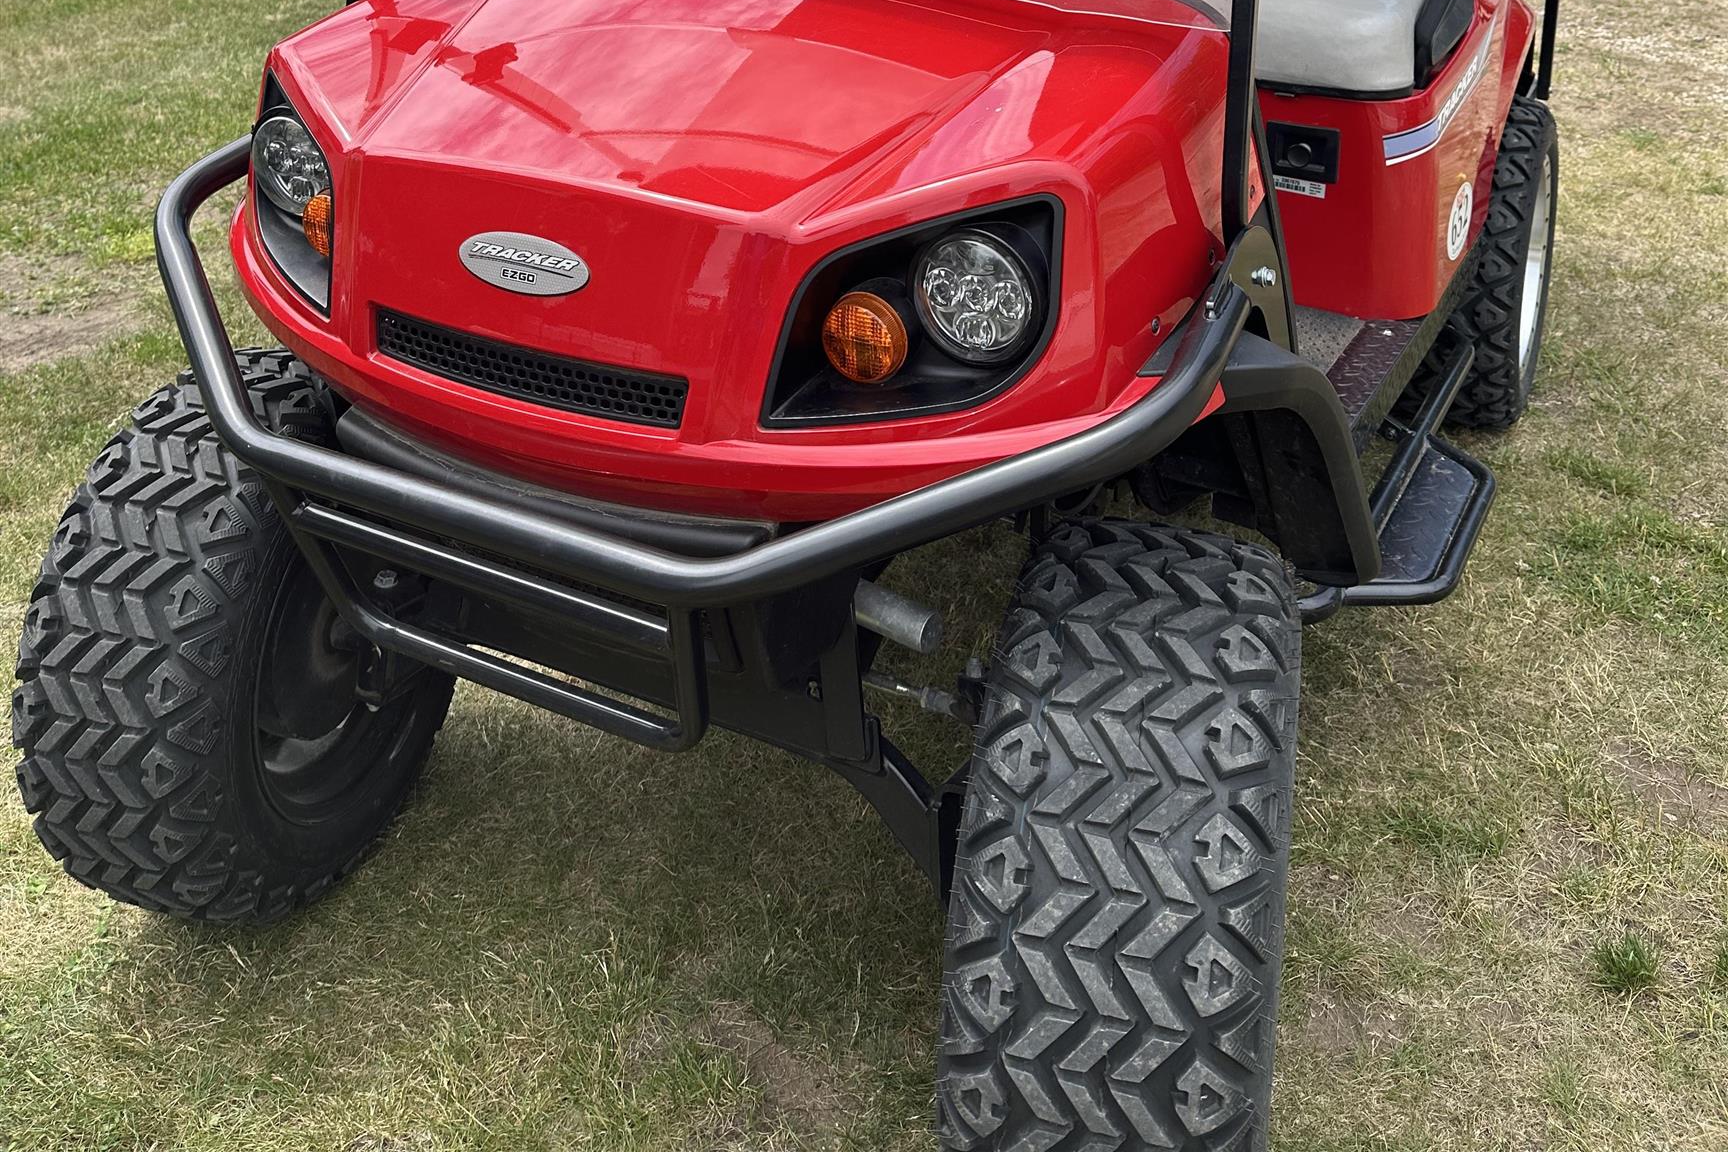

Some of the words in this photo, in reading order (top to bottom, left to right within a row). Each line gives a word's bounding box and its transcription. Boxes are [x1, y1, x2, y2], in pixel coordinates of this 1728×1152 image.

[1437, 56, 1478, 130] TRACKER
[1451, 193, 1469, 246] 652
[472, 241, 580, 272] TRACKER
